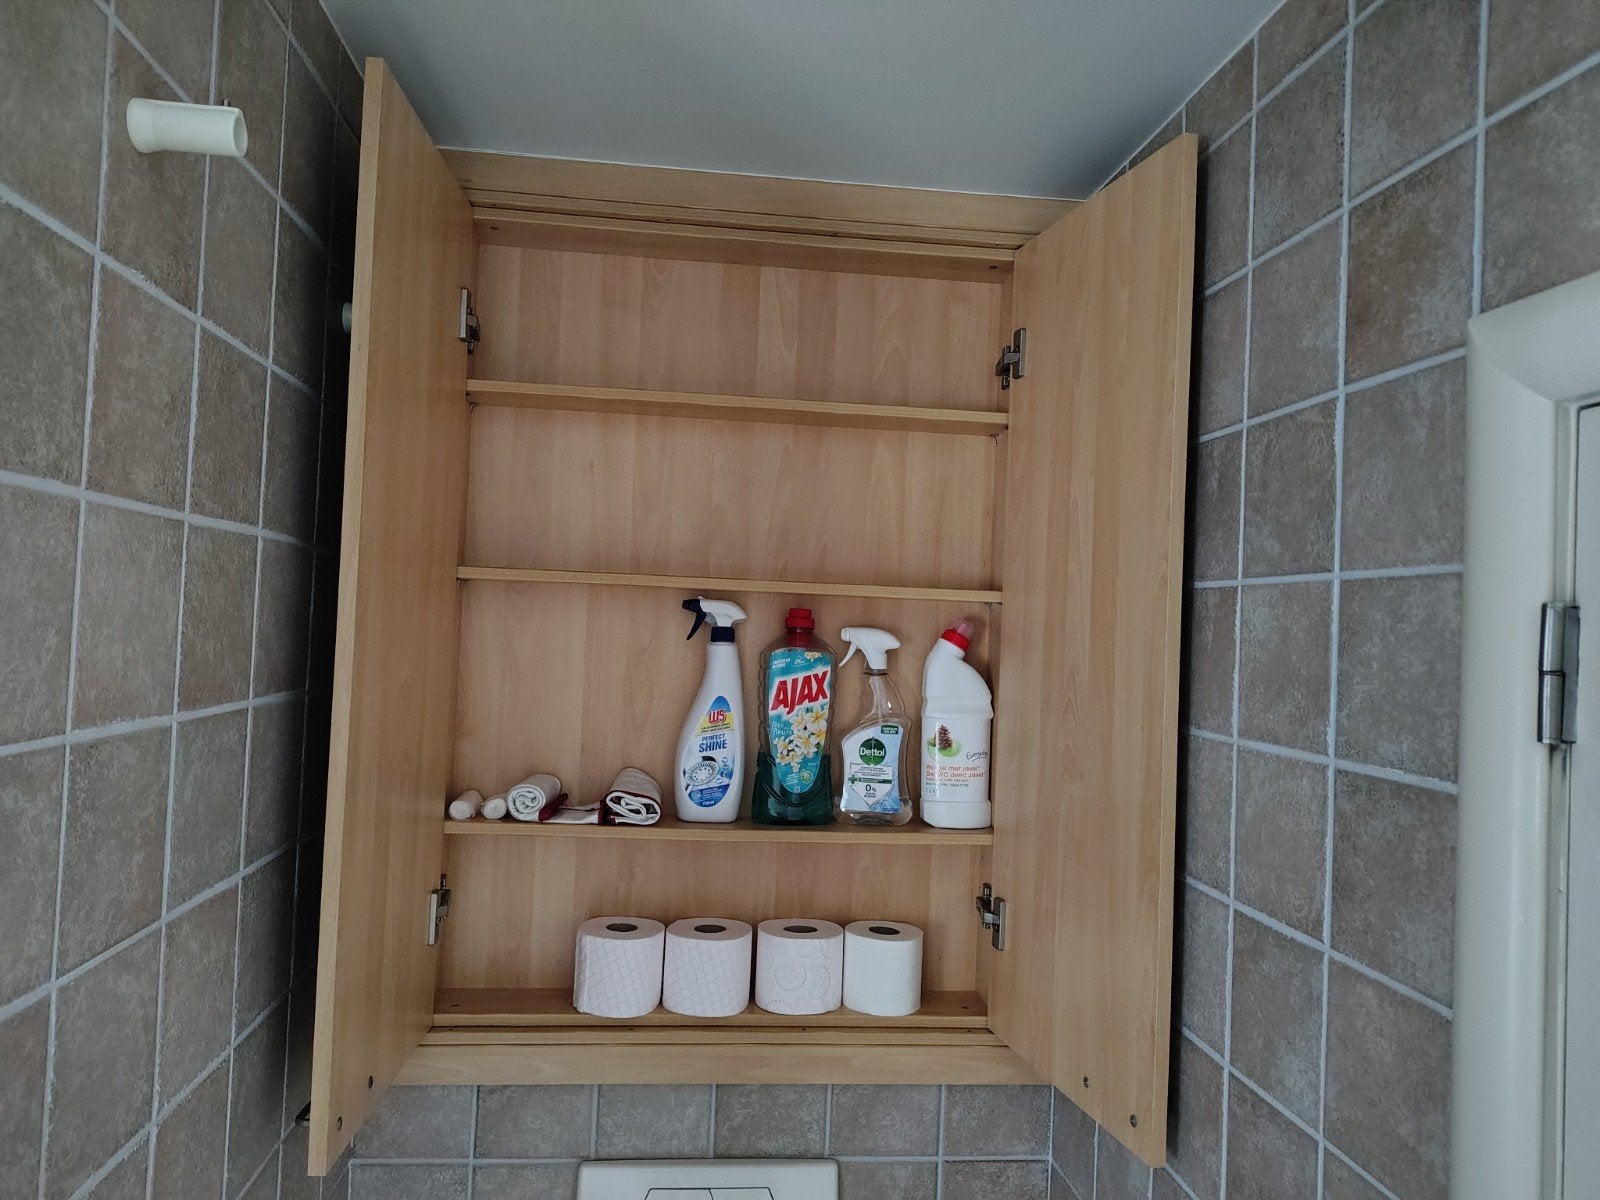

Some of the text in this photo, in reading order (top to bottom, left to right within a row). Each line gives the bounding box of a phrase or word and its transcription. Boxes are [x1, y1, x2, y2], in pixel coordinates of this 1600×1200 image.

[770, 670, 829, 716] AJAX
[709, 709, 727, 724] W5
[701, 733, 725, 742] PERFECT
[698, 739, 728, 753] SHINE
[860, 747, 885, 757] Dettol
